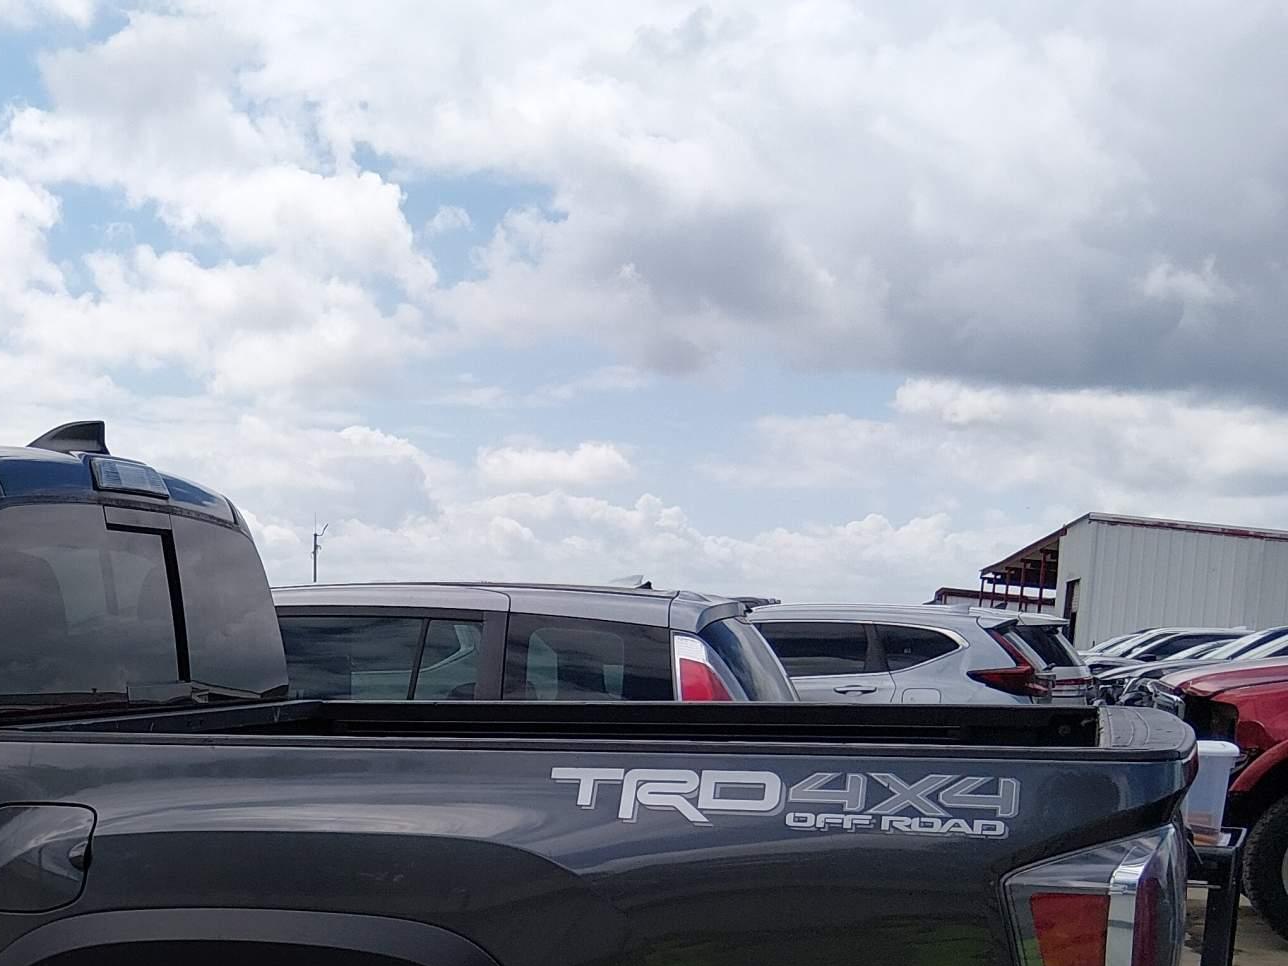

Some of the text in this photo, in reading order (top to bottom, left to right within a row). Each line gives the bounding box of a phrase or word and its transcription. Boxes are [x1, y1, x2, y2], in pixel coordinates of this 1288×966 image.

[550, 766, 1021, 827] TRD 4X4
[784, 810, 1011, 840] OFF ROAD
